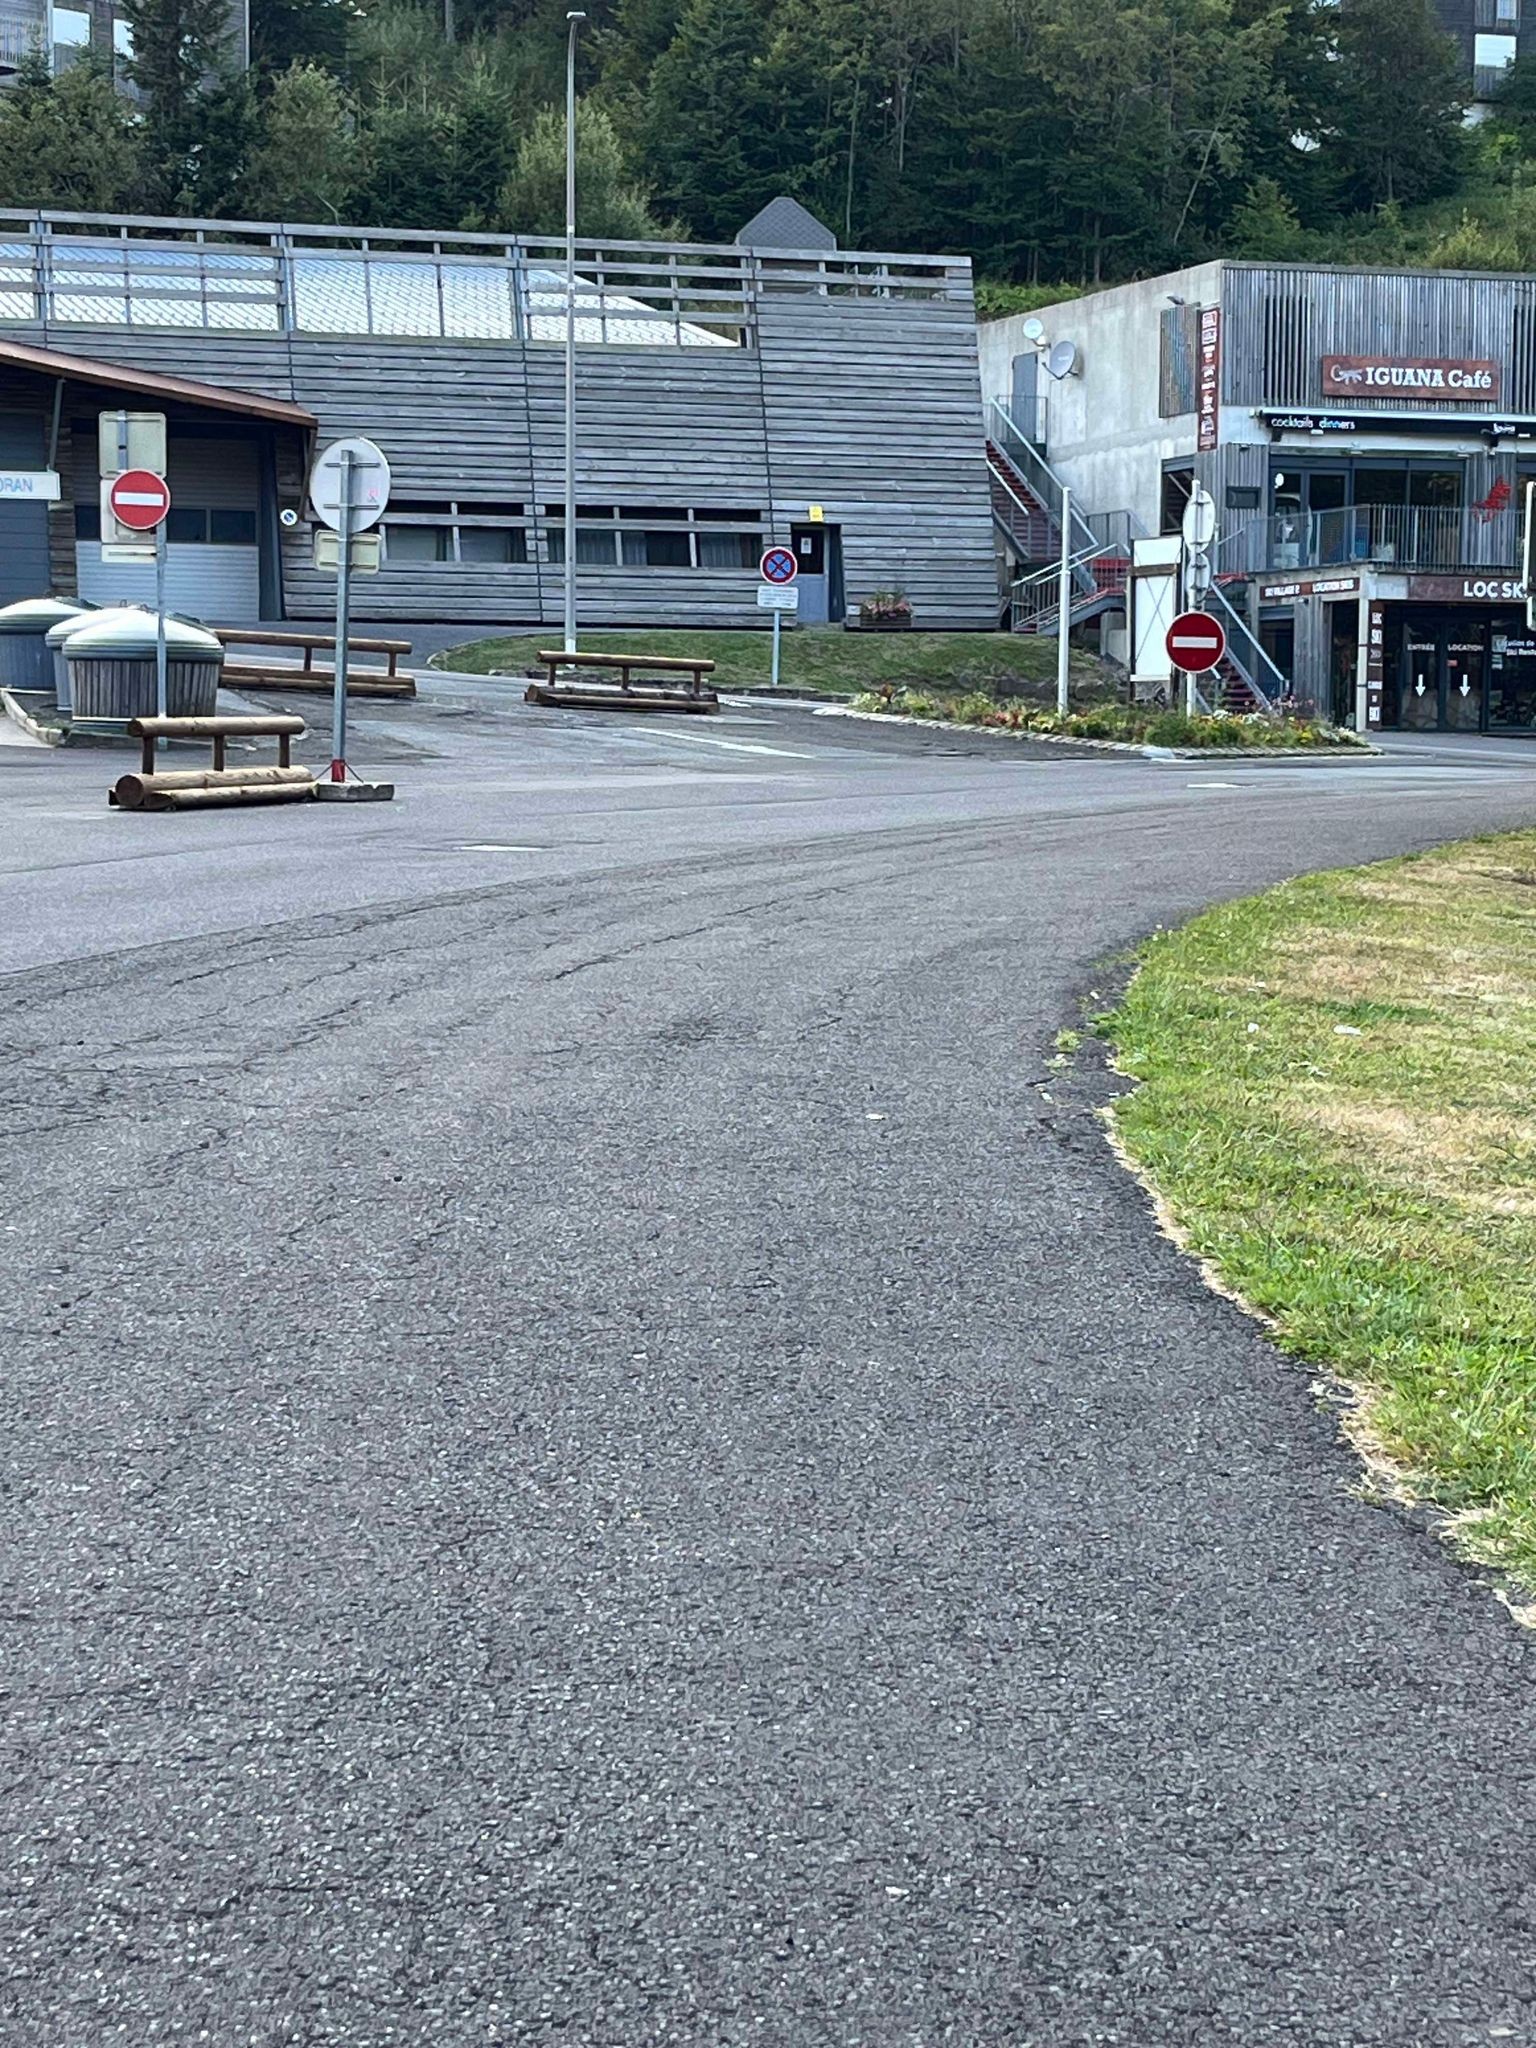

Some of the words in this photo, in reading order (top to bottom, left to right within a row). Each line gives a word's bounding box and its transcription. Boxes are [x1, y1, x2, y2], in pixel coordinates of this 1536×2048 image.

[1365, 367, 1445, 387] IGUANA
[1448, 370, 1492, 389] Café
[1271, 415, 1313, 428] cocktails
[1319, 417, 1355, 429] dinners
[1463, 581, 1498, 598] LOC
[1501, 582, 1528, 598] SK
[1407, 643, 1435, 651] ENTRÉE
